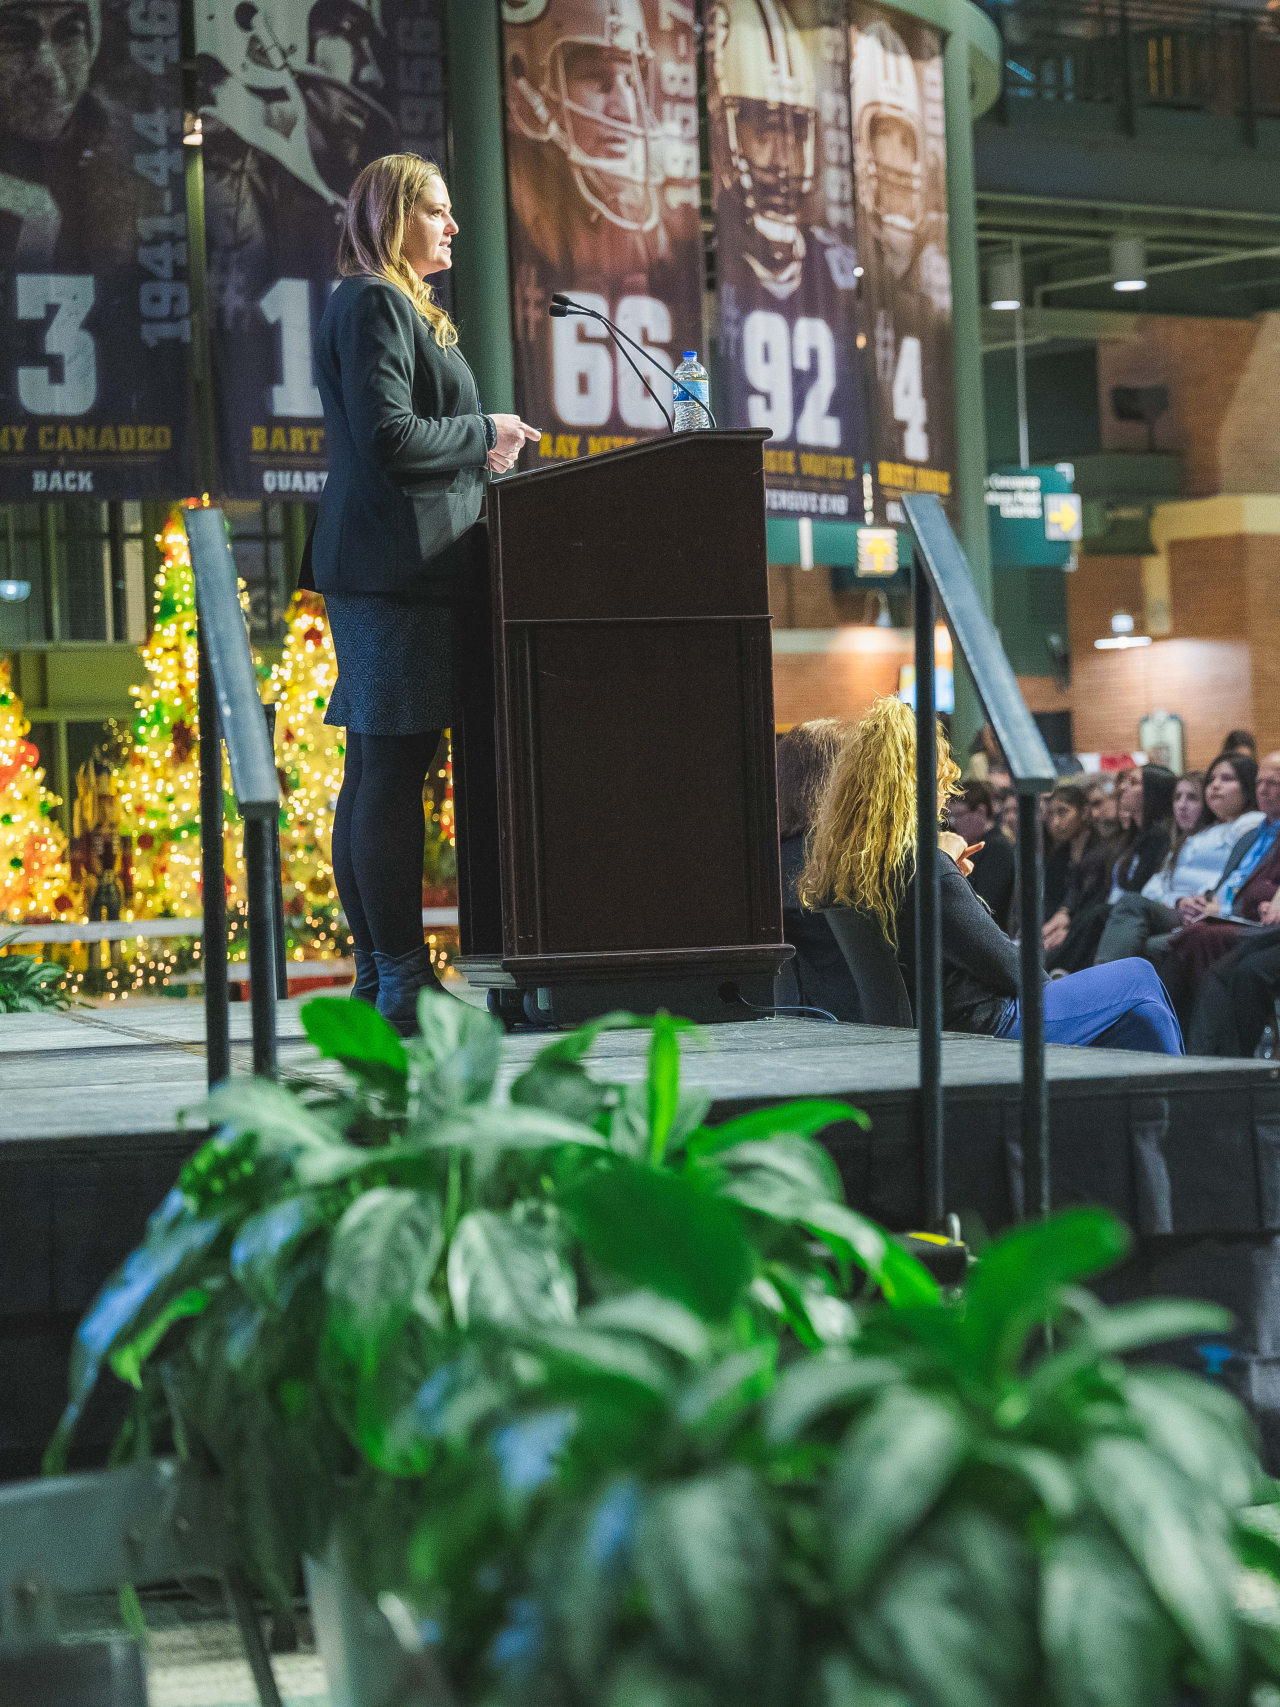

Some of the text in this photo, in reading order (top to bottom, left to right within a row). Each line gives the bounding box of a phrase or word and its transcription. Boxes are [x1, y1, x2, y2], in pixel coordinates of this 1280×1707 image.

[17, 273, 98, 417] 3
[552, 291, 678, 430] 66
[743, 310, 842, 448] 92
[893, 336, 929, 462] 4
[32, 470, 94, 493] BACK
[251, 426, 325, 451] BART
